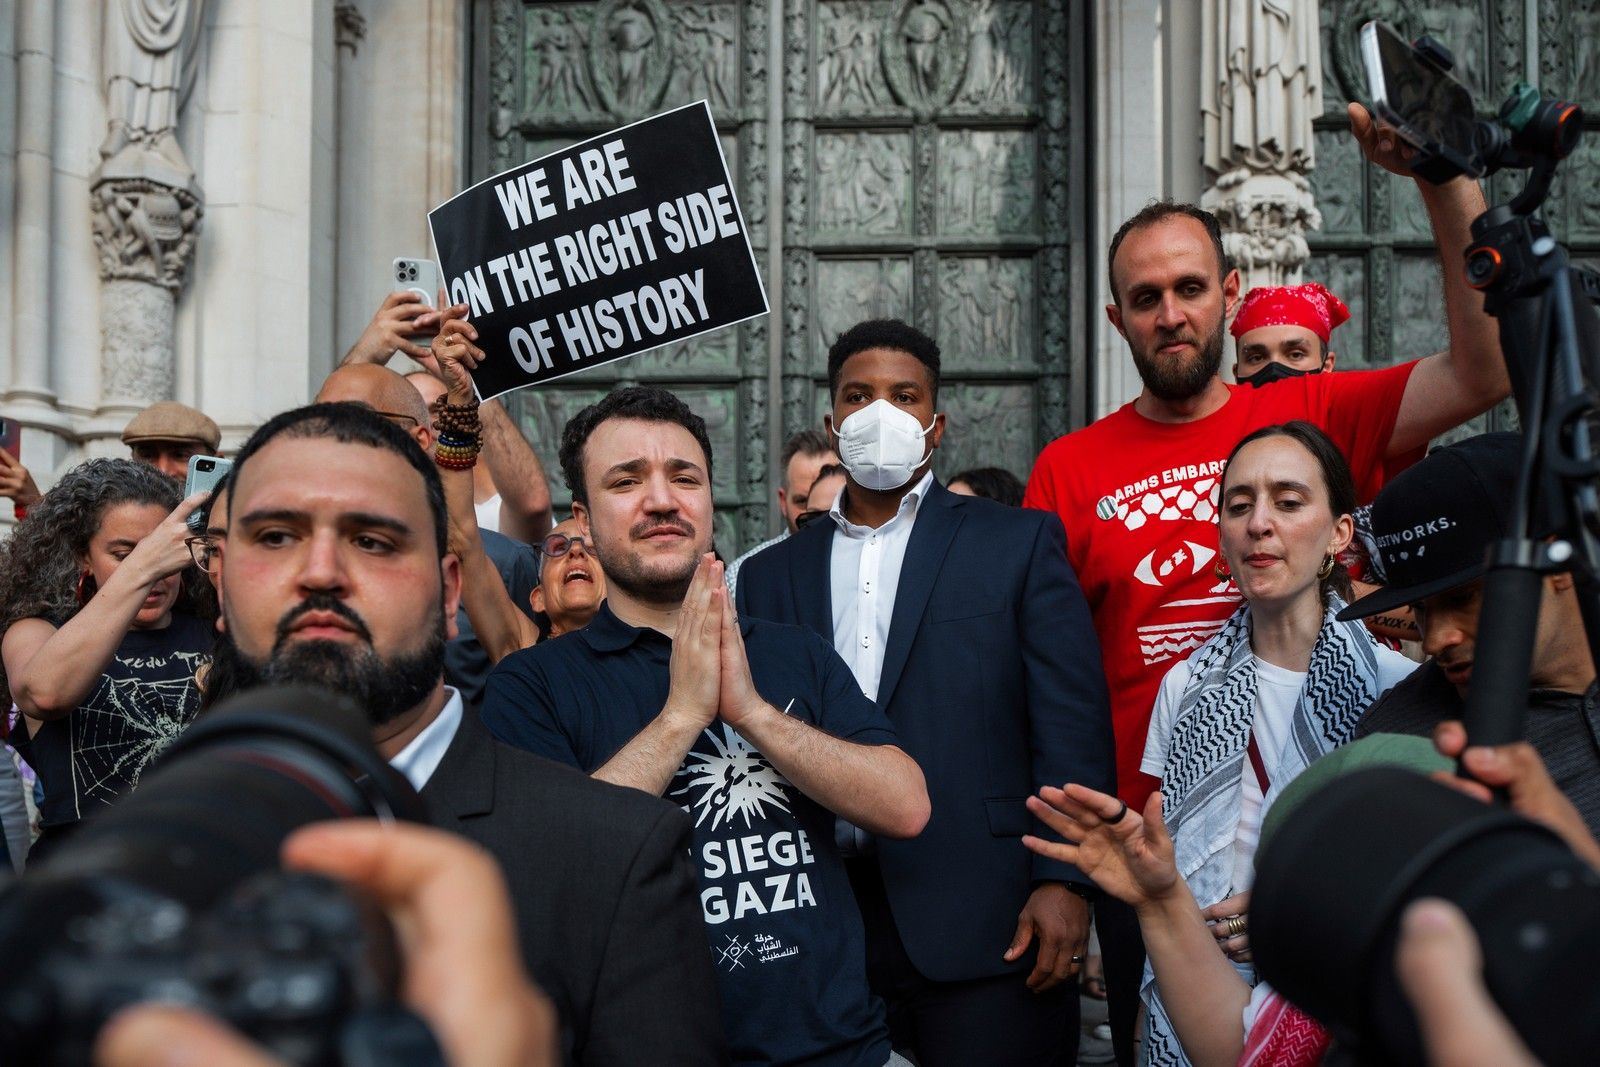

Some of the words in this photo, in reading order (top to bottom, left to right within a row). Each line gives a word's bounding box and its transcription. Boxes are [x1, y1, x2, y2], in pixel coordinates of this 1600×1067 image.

[494, 167, 557, 231] WE
[561, 139, 637, 210] ARE
[451, 265, 494, 322] ON
[488, 242, 561, 307] THE
[554, 208, 658, 287] RIGHT
[657, 184, 740, 254] SIDE
[509, 318, 554, 374] OF
[556, 268, 709, 361] HISTORY
[1115, 475, 1160, 501] ARMS
[702, 830, 815, 879] SIEGE
[700, 872, 817, 925] GAZA
[757, 939, 781, 954] الشباب
[759, 946, 799, 963] الفلسطيني
